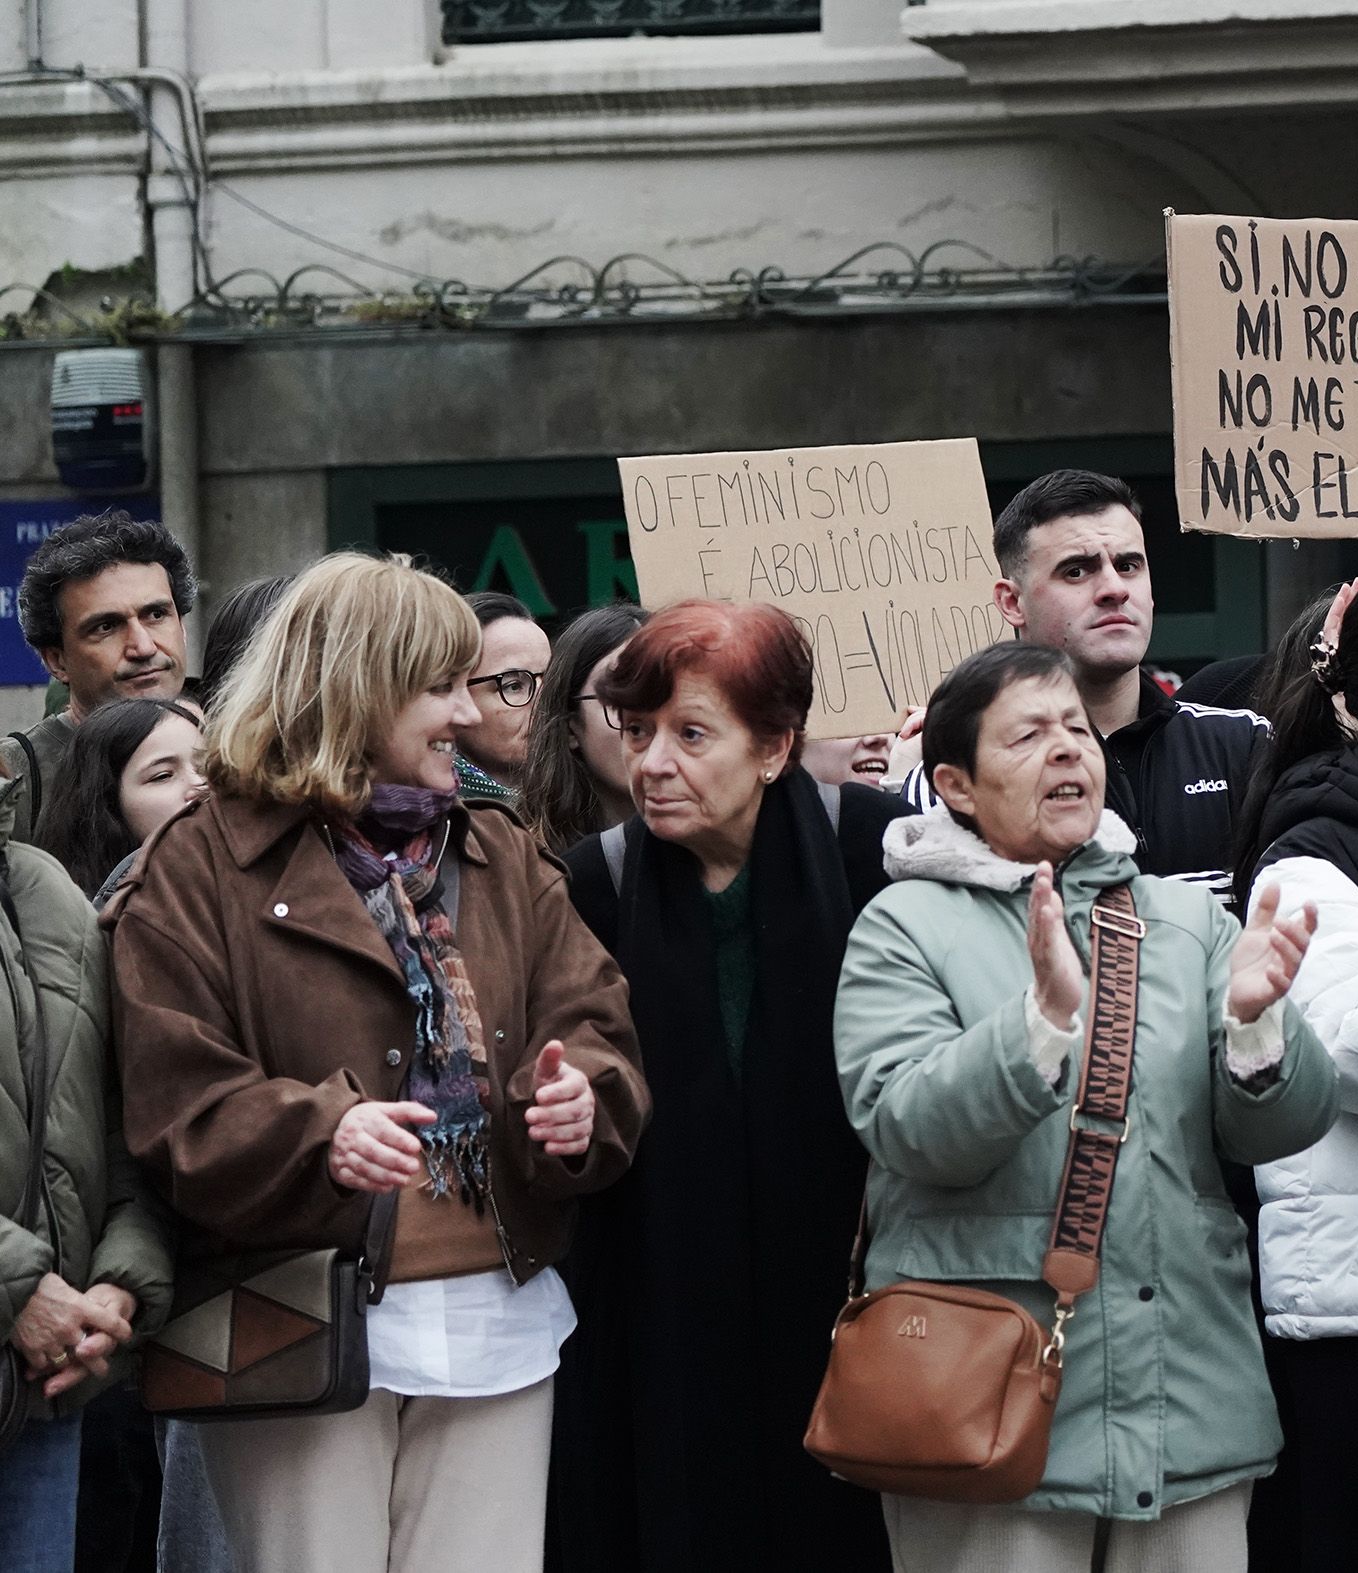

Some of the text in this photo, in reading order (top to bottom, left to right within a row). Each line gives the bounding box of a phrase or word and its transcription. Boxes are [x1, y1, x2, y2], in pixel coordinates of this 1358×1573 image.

[1236, 284, 1283, 362] MI
[1218, 368, 1273, 429] NO
[1291, 376, 1345, 435] ME
[1200, 436, 1301, 523] MÁS
[472, 518, 642, 614] AR
